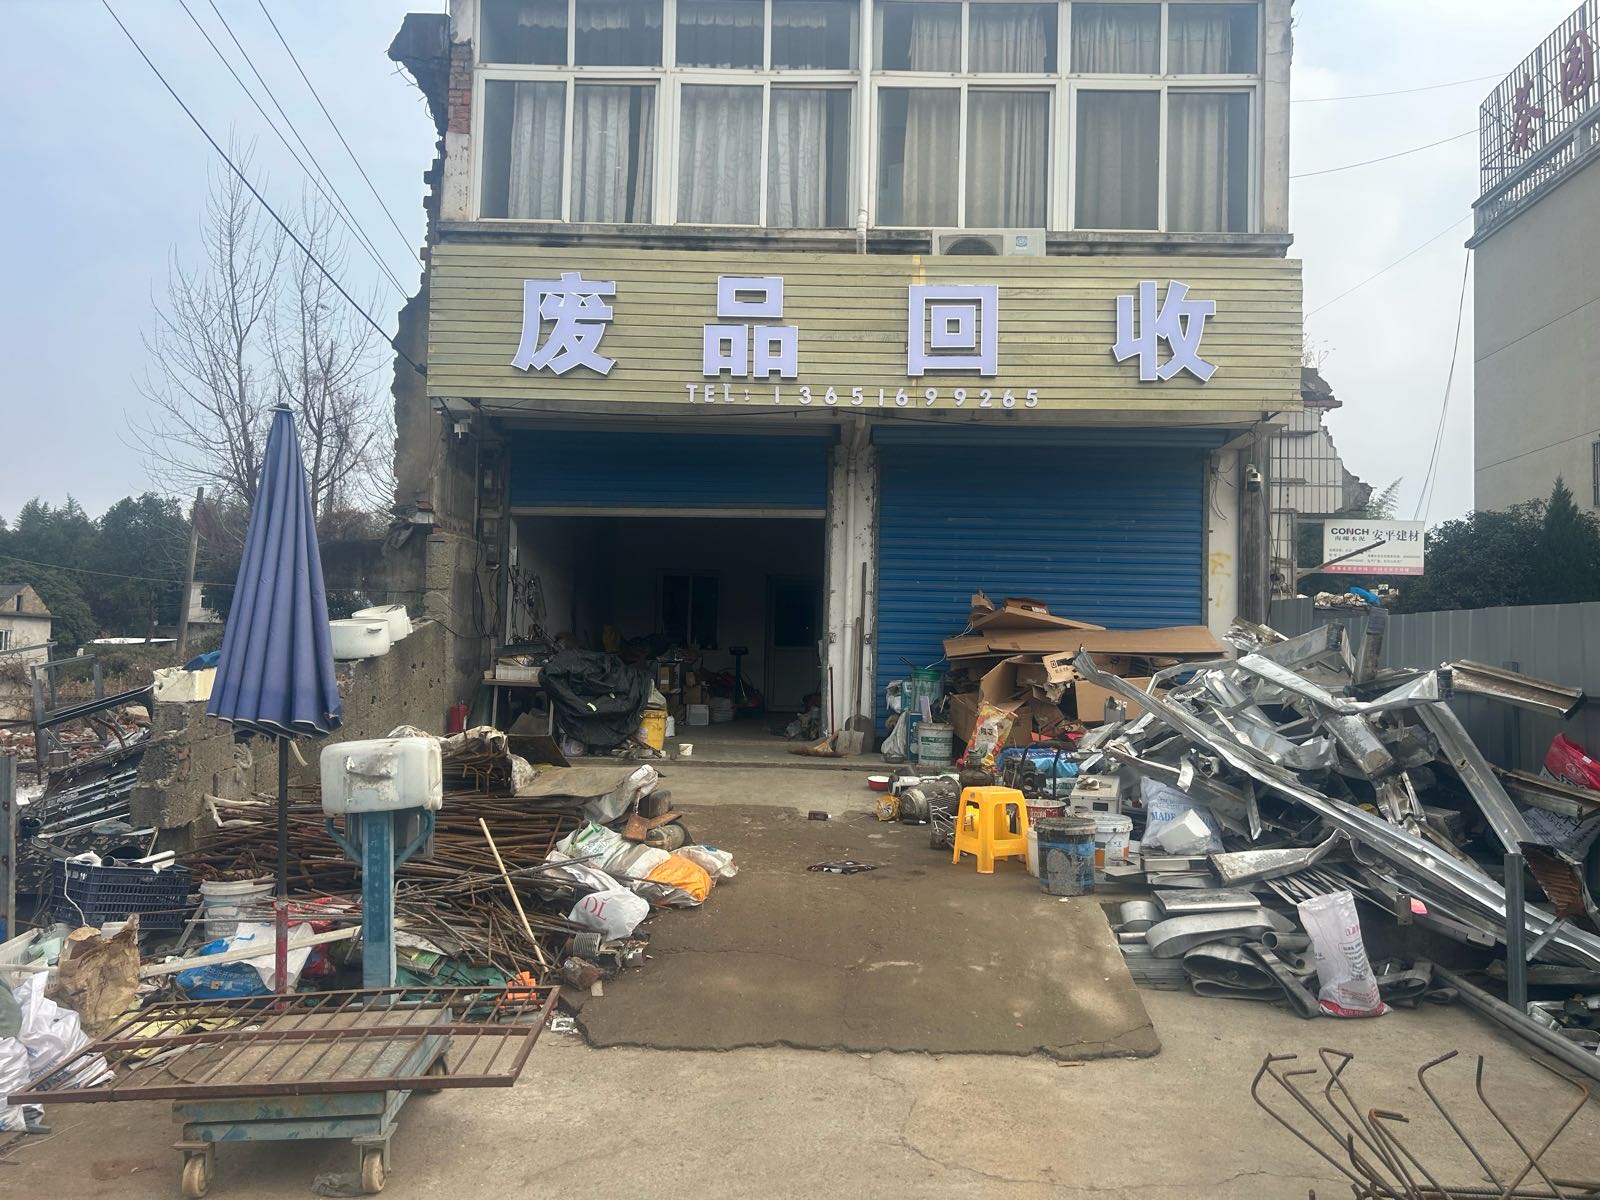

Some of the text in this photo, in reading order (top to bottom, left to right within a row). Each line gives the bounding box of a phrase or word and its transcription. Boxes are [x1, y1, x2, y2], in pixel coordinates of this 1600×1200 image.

[512, 272, 1218, 382] 废品回收
[686, 383, 1038, 408] TEL: 13651699265
[1331, 527, 1369, 535] CONCH
[1372, 529, 1420, 542] 安平建材
